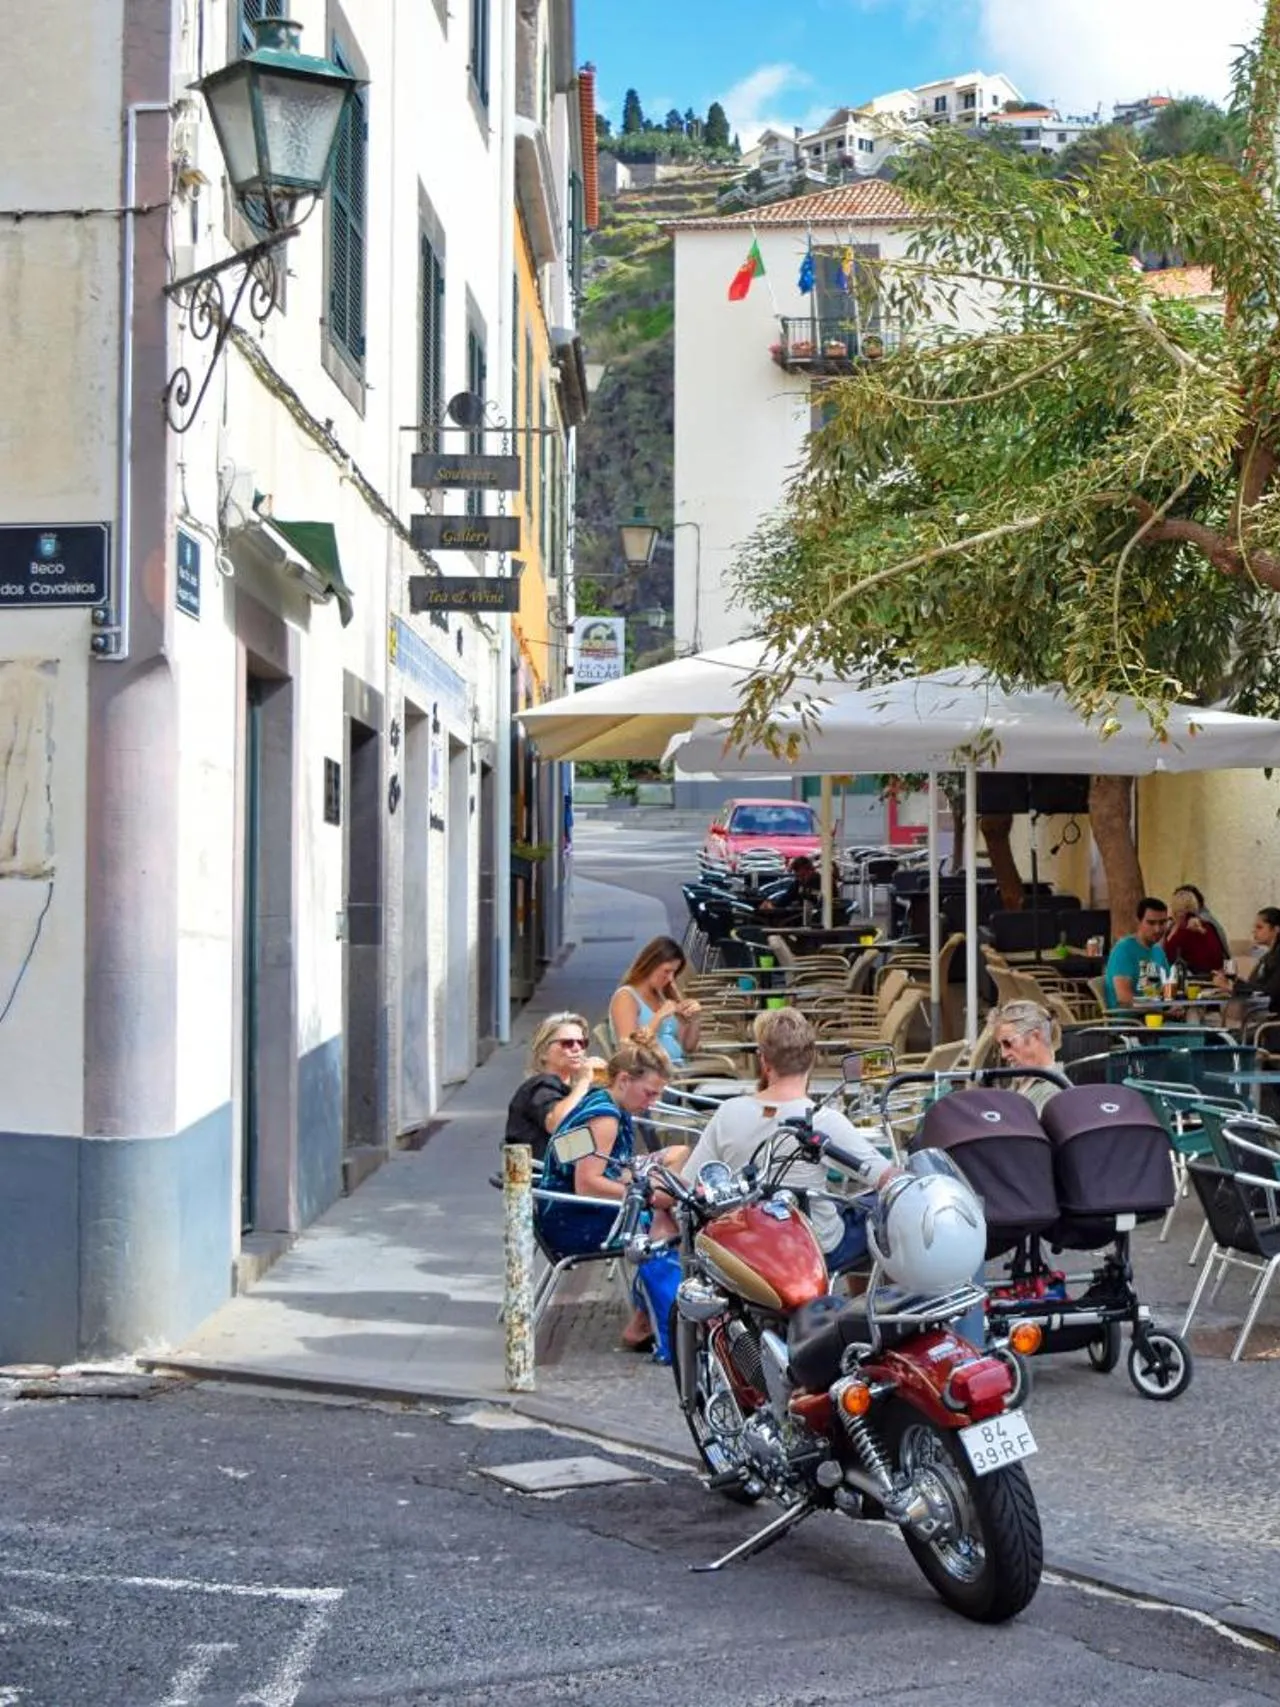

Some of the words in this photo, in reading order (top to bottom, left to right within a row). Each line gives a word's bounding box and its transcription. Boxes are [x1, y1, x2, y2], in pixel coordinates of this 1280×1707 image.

[442, 527, 489, 545] Gallery
[30, 562, 65, 575] Beco
[0, 582, 24, 596] dos
[29, 582, 96, 596] Cavaleiros
[429, 590, 448, 603] Tea
[471, 590, 505, 604] Wine
[980, 1421, 1007, 1443] 84
